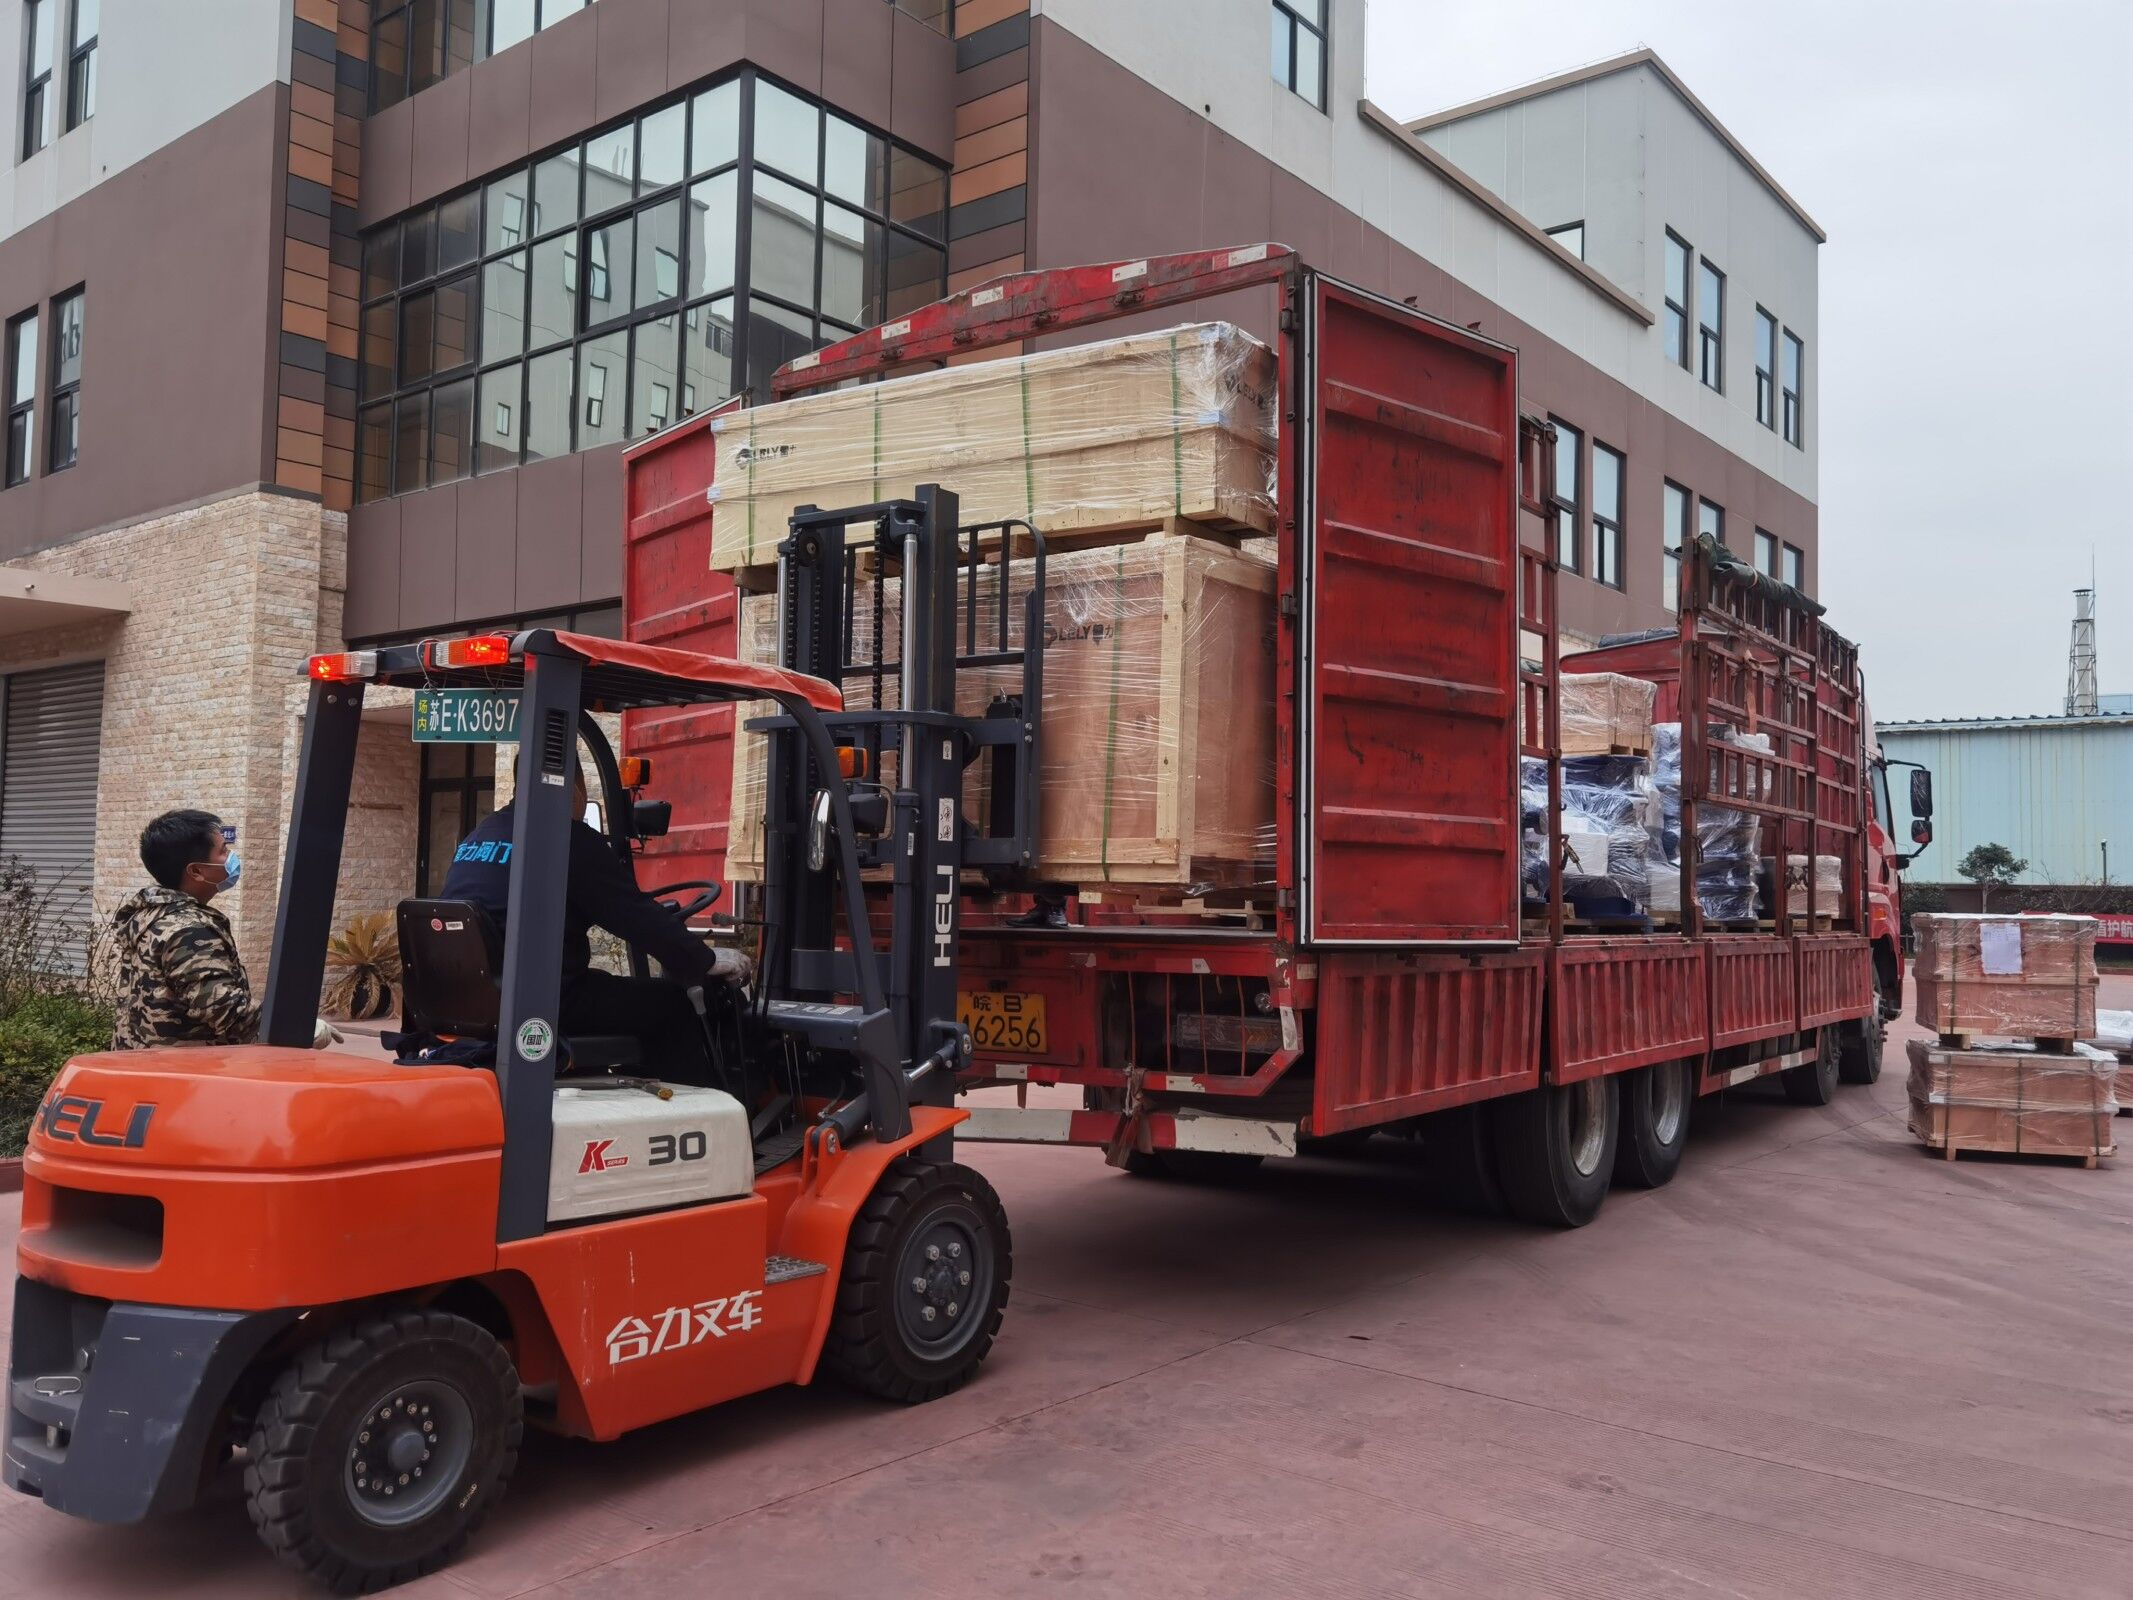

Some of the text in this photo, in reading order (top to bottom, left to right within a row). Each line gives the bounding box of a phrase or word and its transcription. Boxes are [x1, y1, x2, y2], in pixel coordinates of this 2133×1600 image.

[417, 700, 428, 732] 场内
[934, 865, 953, 967] HELI
[578, 1130, 707, 1174] K 30
[605, 1289, 763, 1366] 合力叉车
